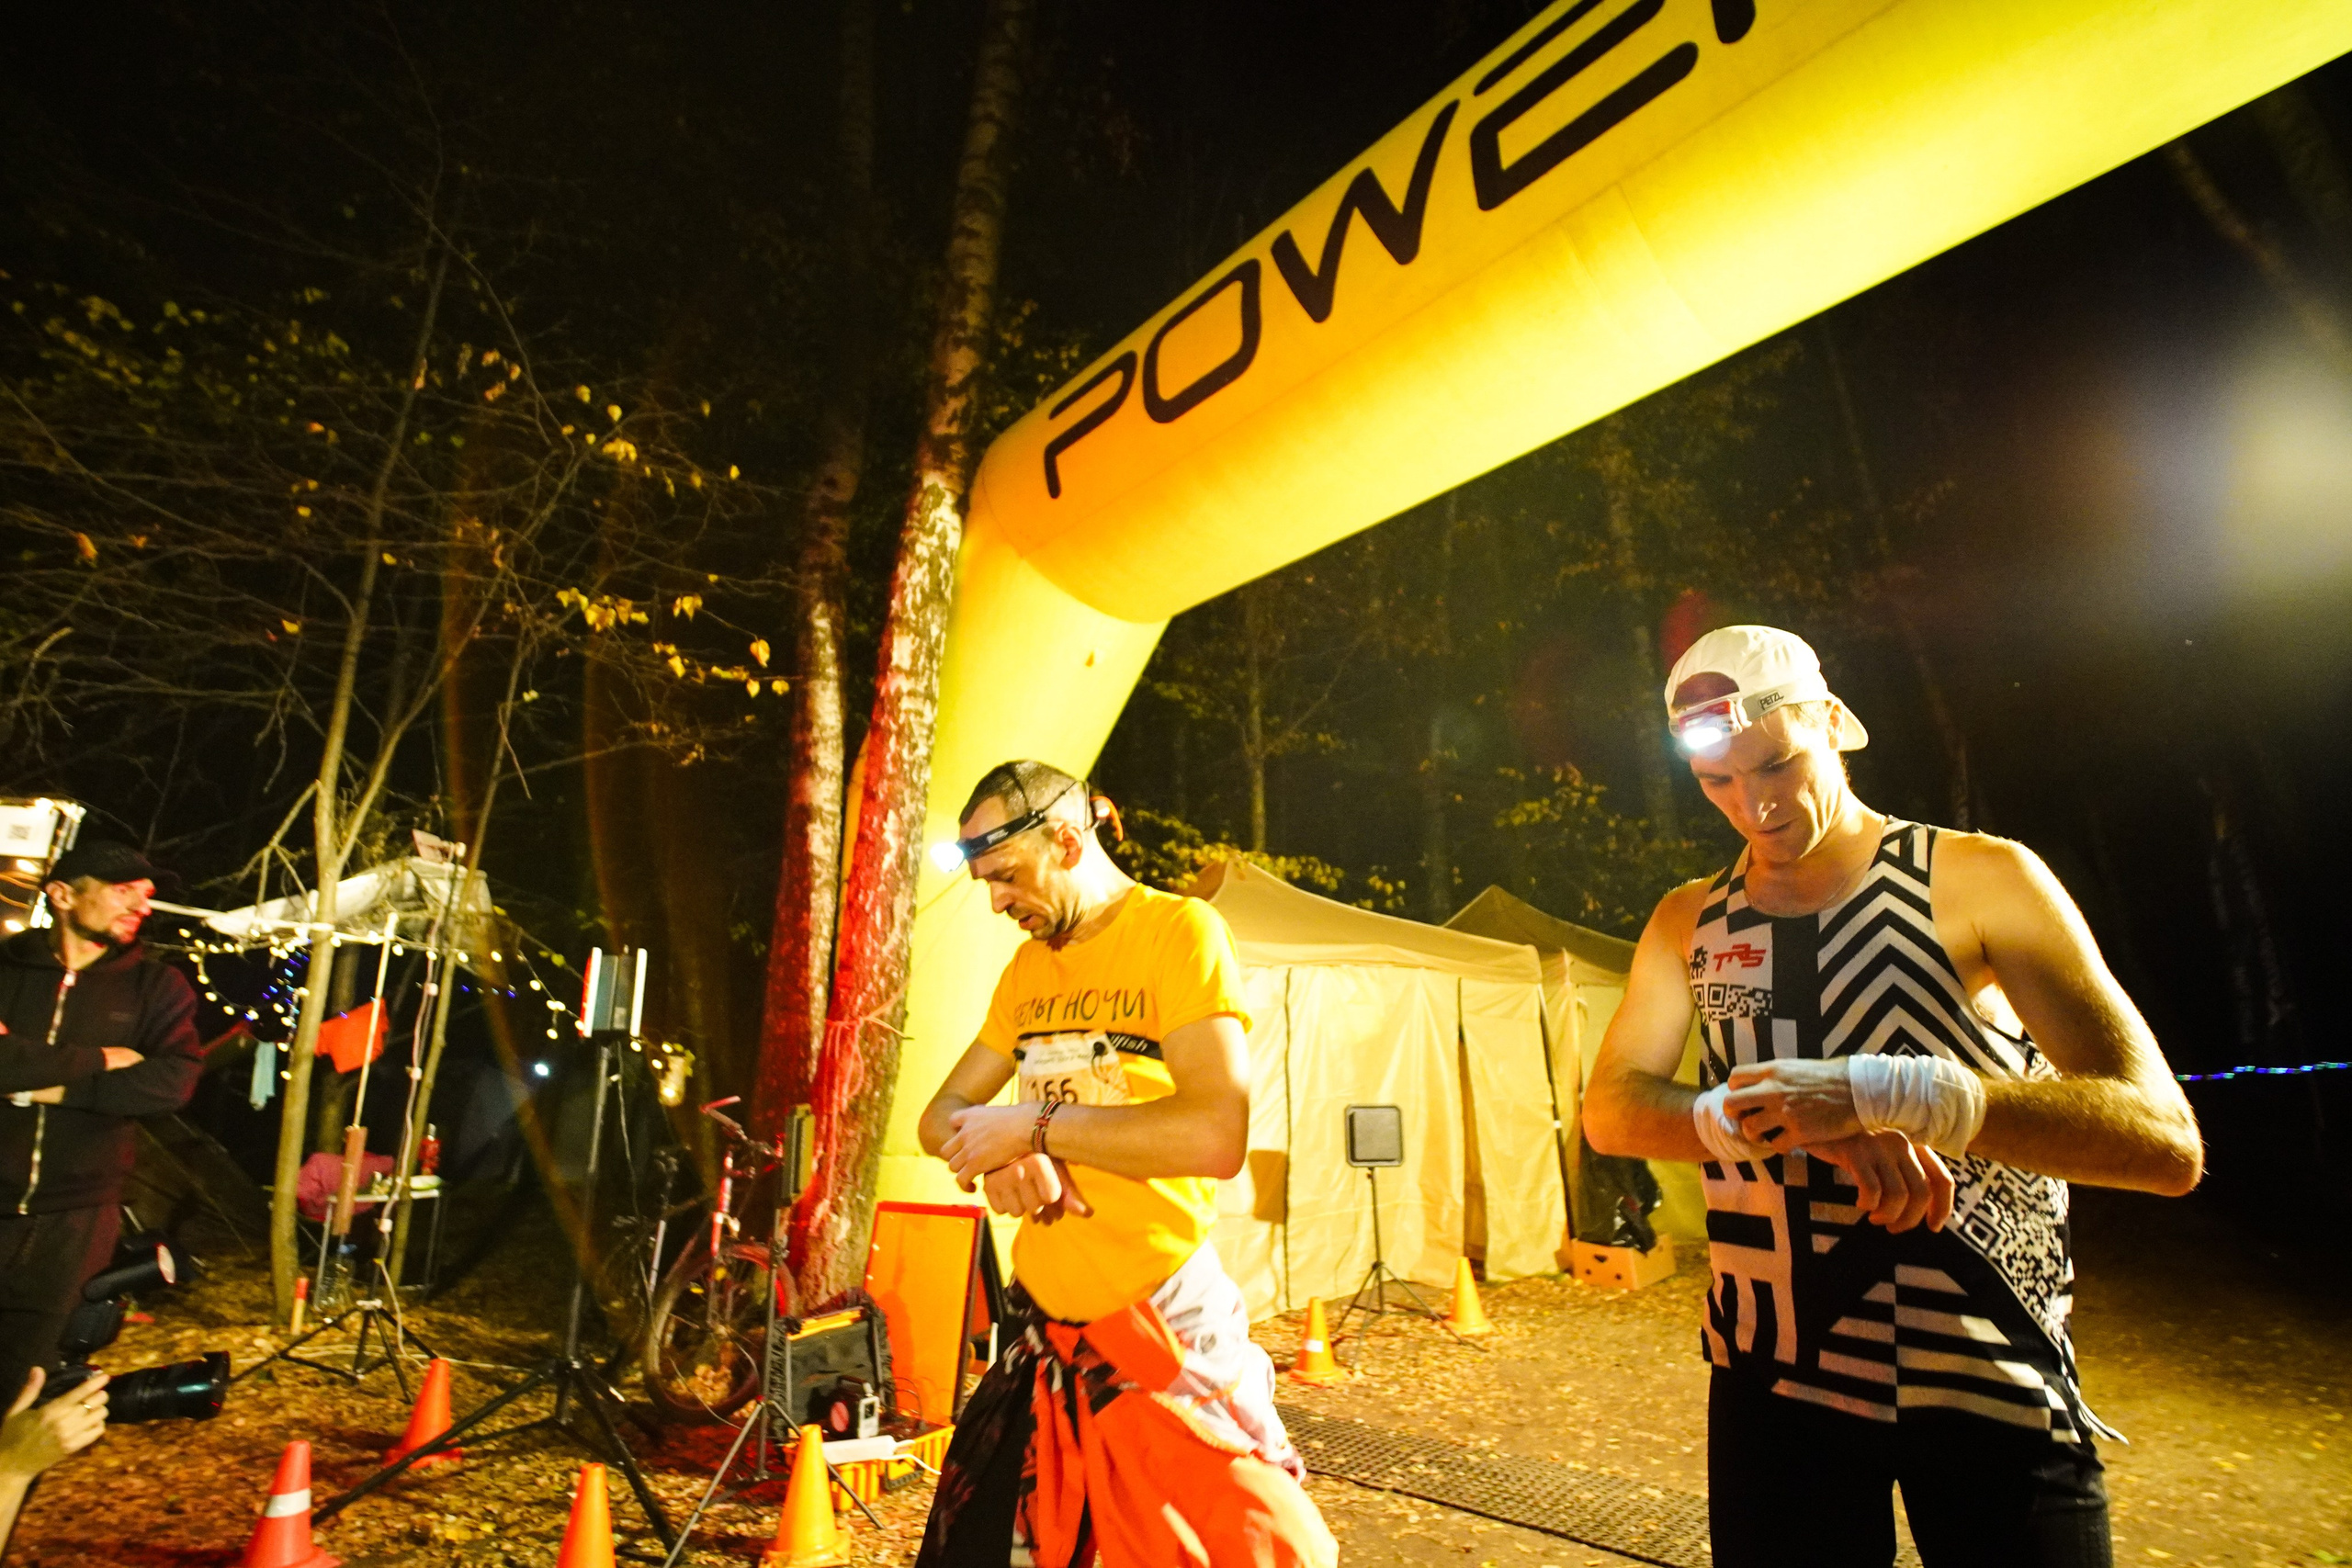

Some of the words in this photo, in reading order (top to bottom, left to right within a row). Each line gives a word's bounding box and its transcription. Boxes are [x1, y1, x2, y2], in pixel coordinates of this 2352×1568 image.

[1759, 692, 1785, 711] PETZL
[1063, 987, 1145, 1021] НОЧИ
[1031, 1078, 1079, 1104] 166
